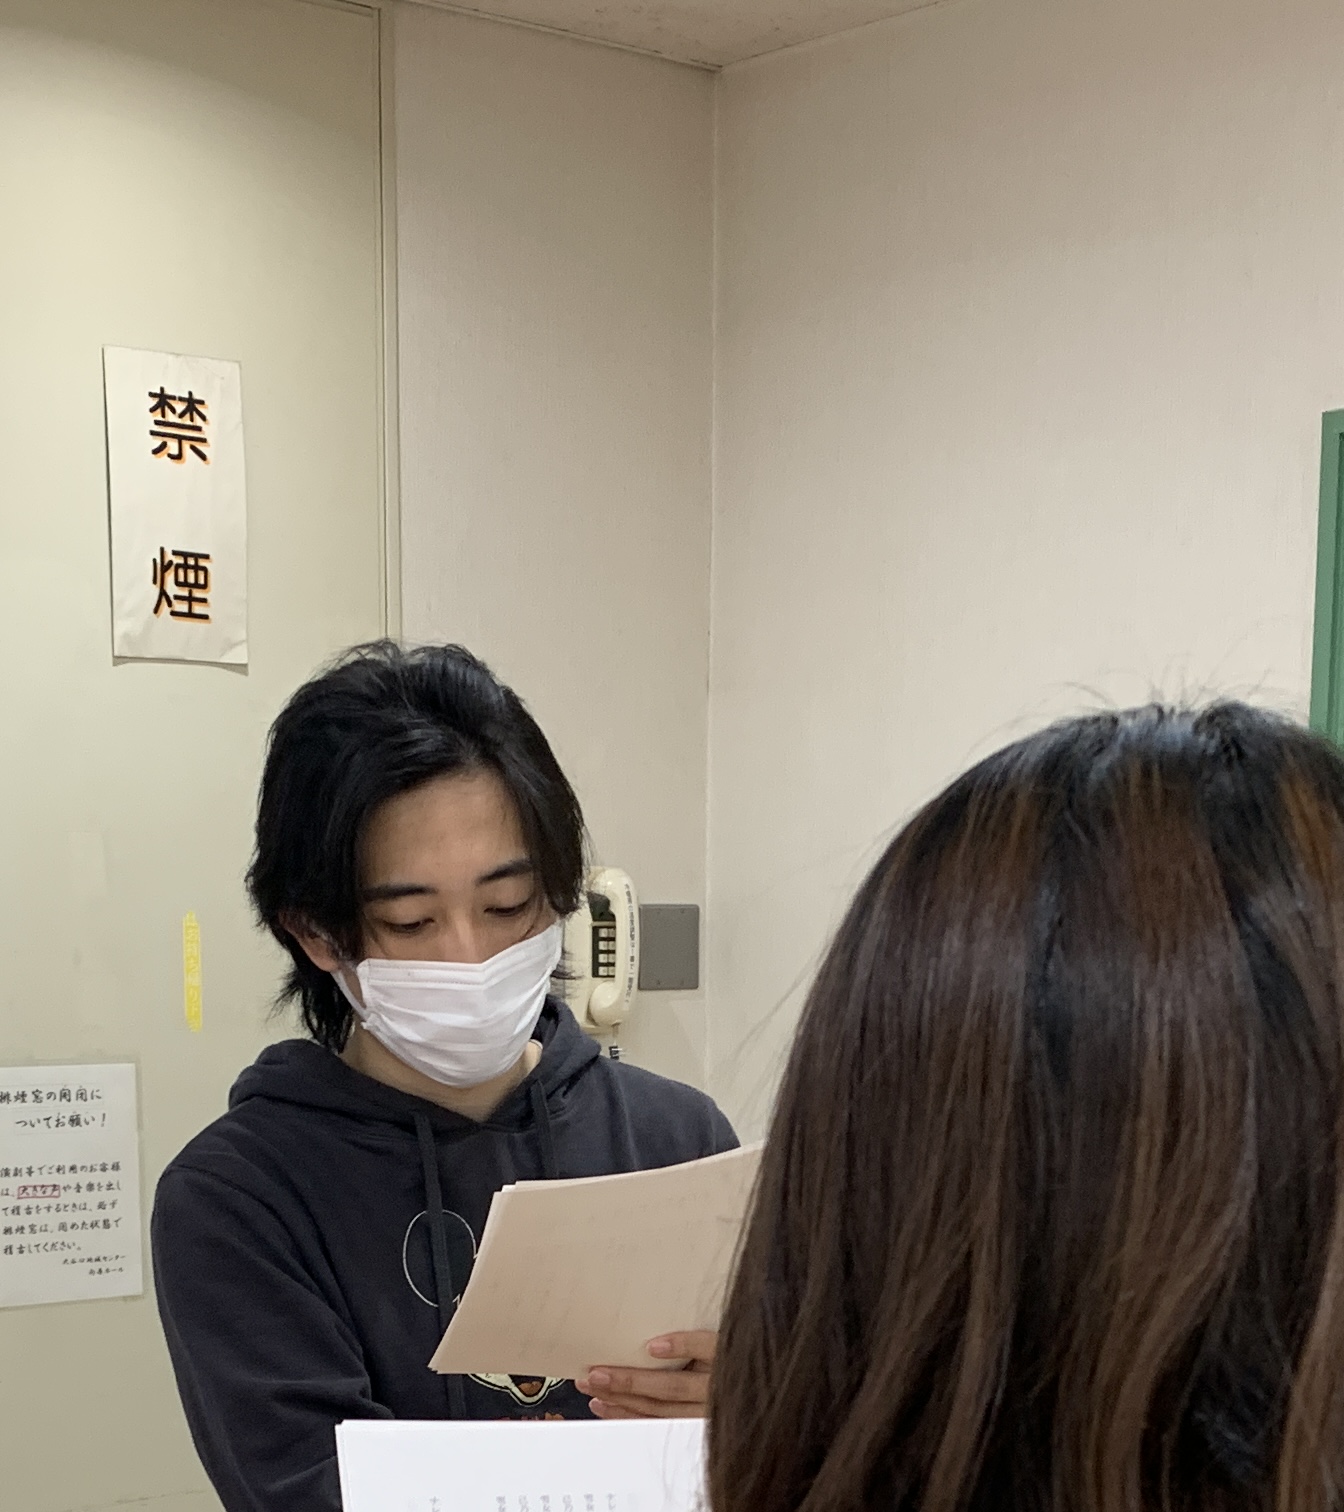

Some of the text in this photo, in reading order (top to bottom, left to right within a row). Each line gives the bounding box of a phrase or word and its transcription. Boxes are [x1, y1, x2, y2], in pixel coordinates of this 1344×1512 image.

[147, 386, 212, 625] 禁煙
[0, 1161, 122, 1178] 演劇等でご利用のお客様
